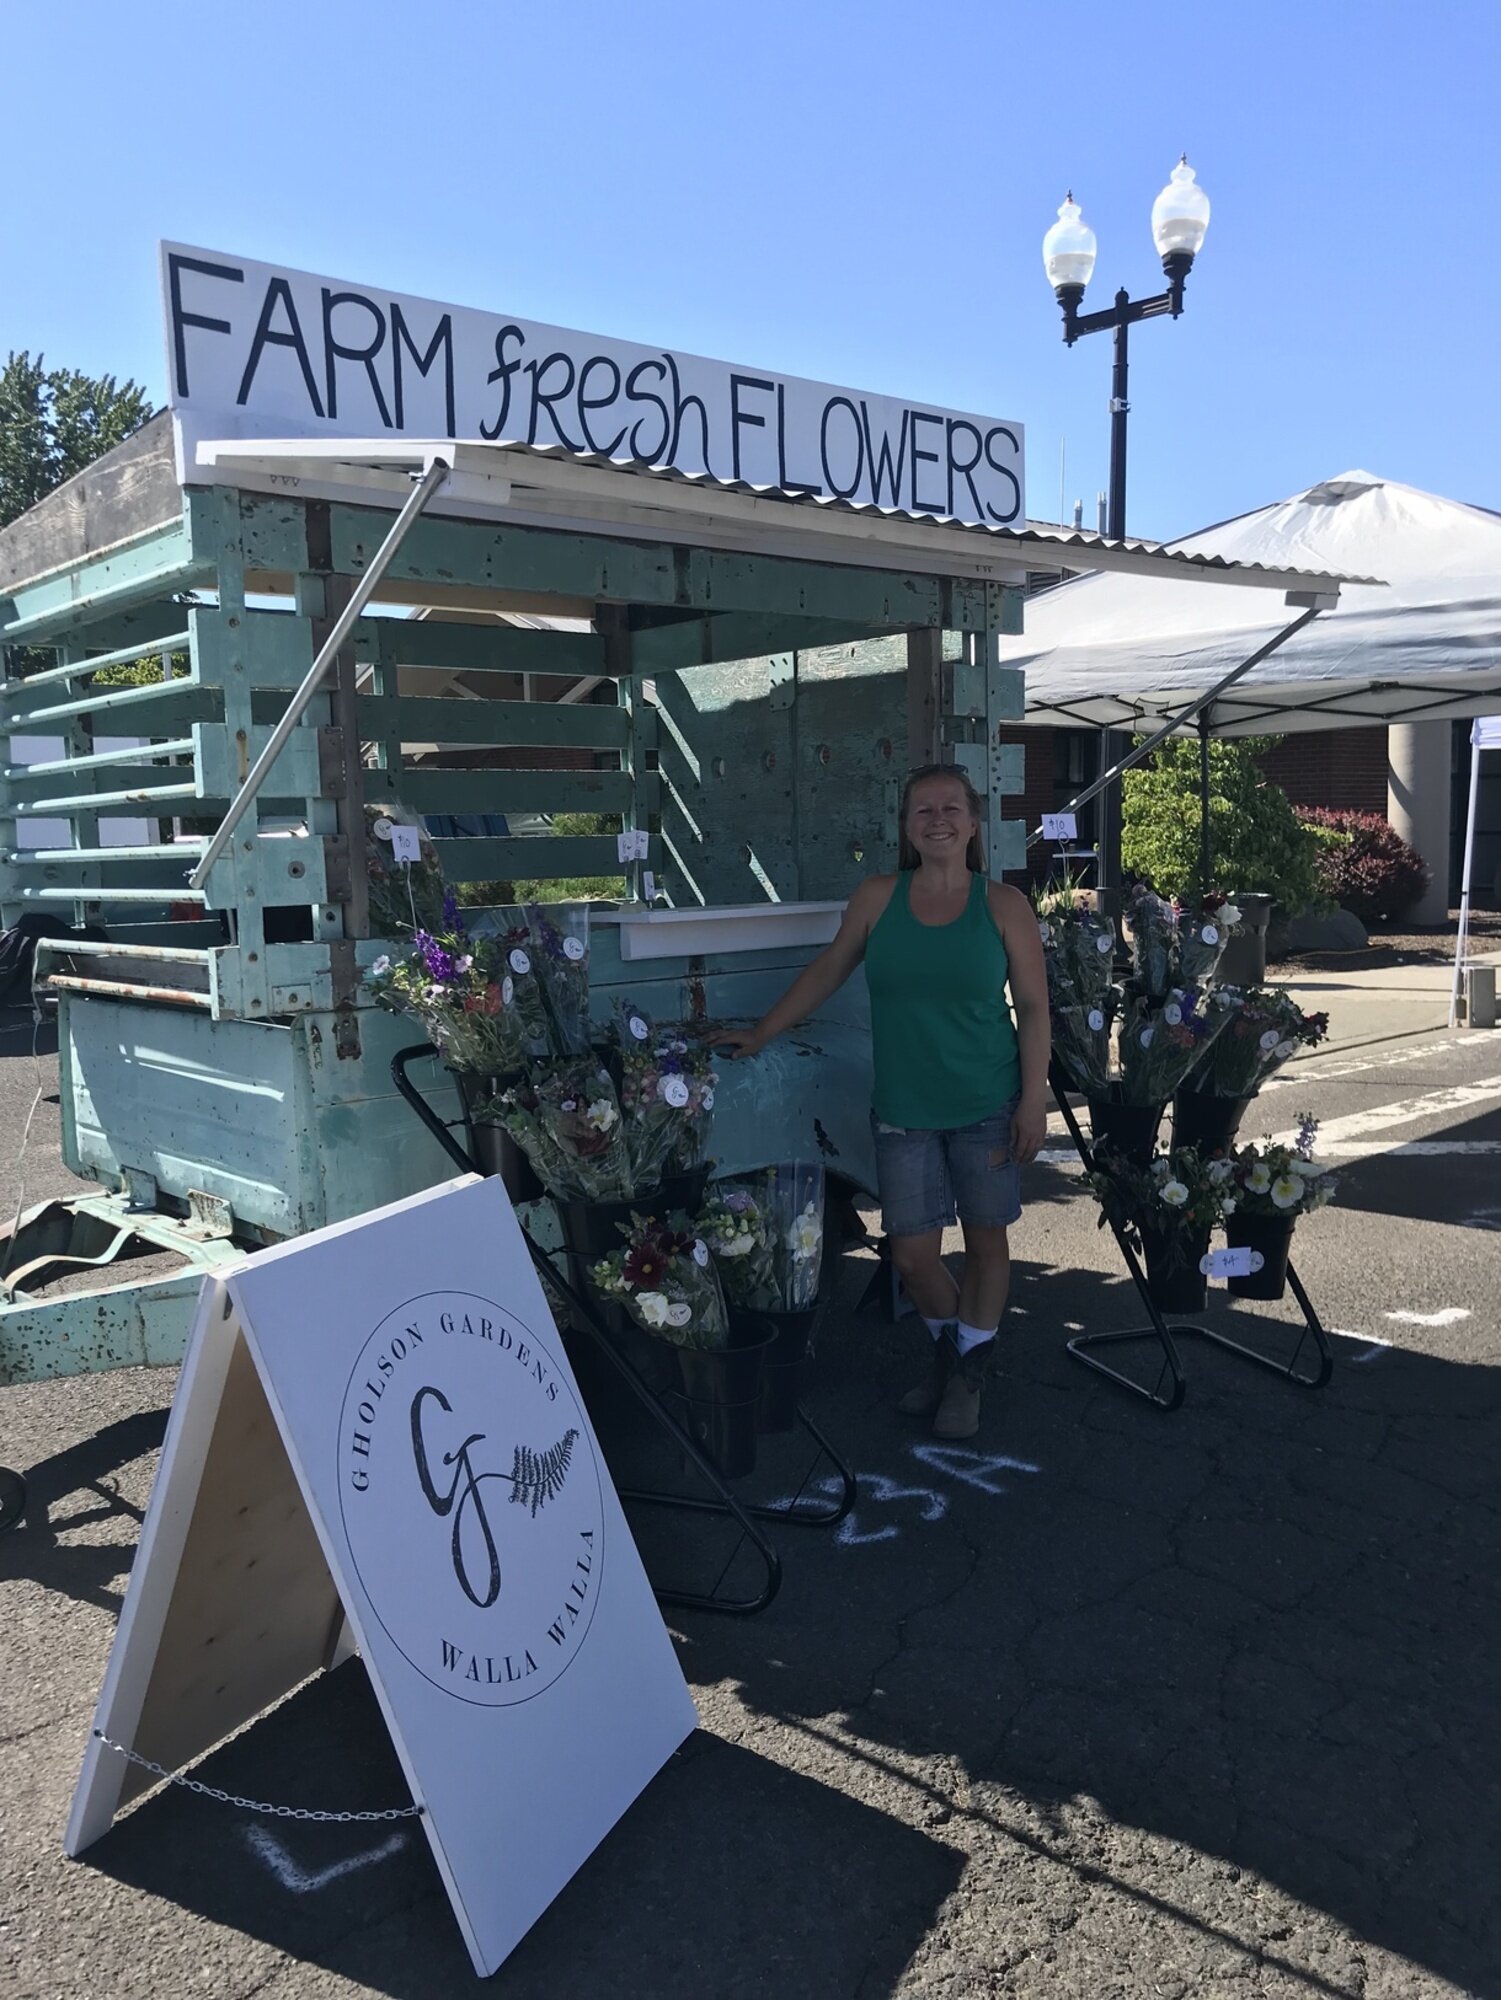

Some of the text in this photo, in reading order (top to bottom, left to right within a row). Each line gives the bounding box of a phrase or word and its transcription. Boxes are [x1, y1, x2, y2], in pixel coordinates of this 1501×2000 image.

[168, 252, 456, 438] FARM
[730, 373, 1021, 524] FLOWERS
[351, 1312, 560, 1492] GHOLSON GARDENS
[440, 1528, 594, 1685] WALLA WALLA
